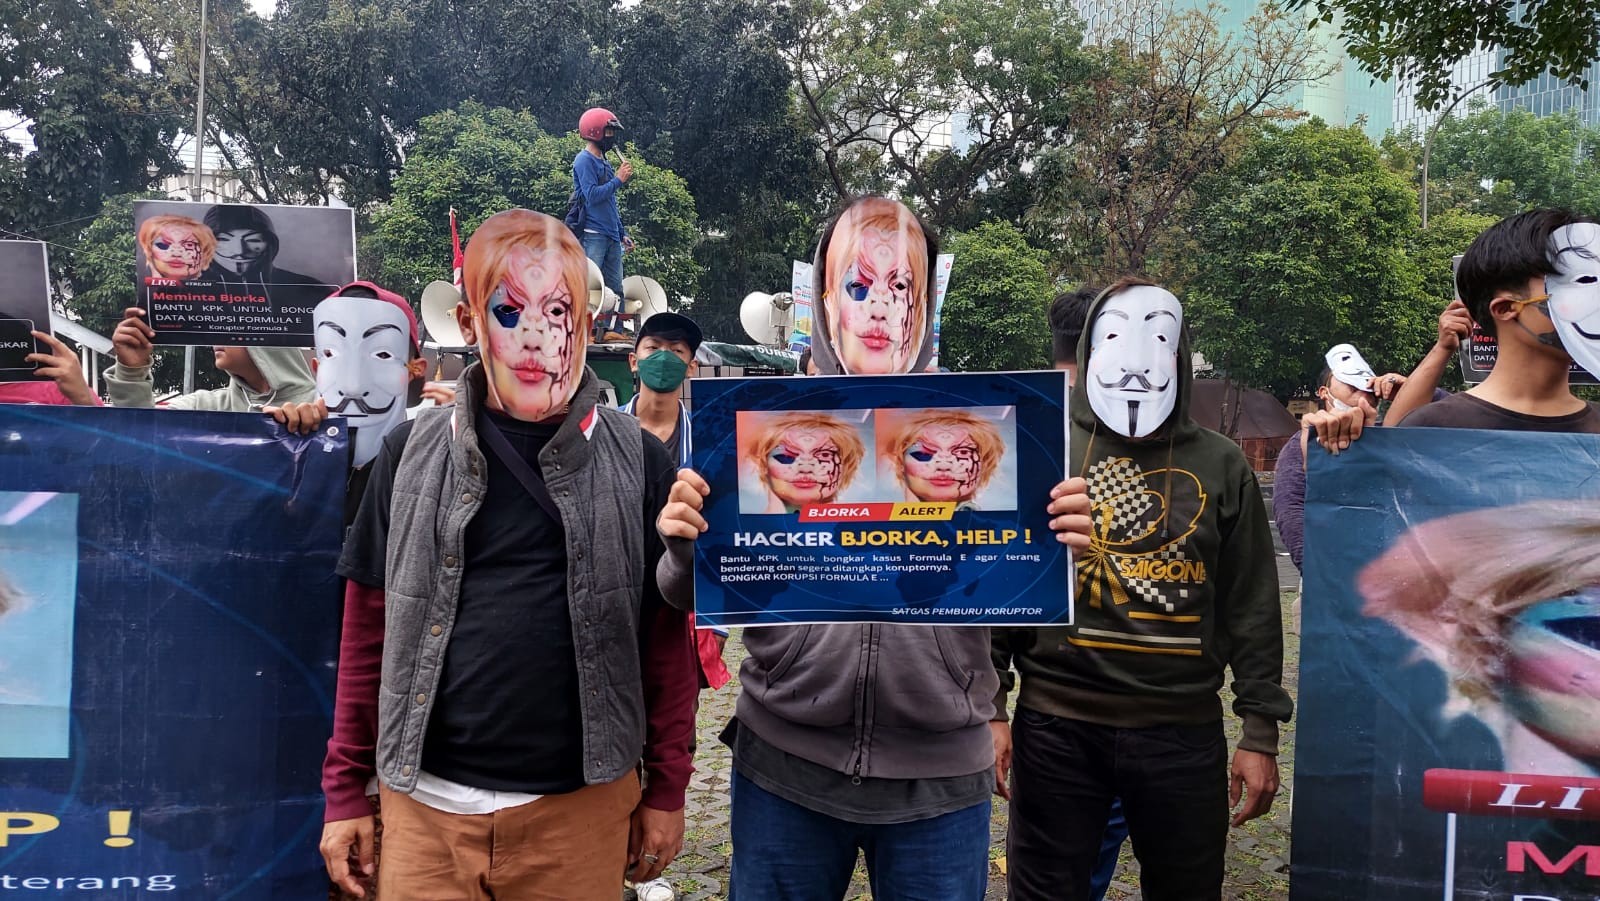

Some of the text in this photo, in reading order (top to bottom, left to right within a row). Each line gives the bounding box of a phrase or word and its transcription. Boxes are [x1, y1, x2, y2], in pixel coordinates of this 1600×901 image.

[151, 279, 177, 287] LIVE
[153, 292, 266, 304] Meminta Bjorka
[154, 303, 193, 311] BANTU
[232, 305, 272, 313] UNTUK
[281, 306, 314, 314] BONG
[208, 324, 245, 332] Koruptor
[808, 506, 946, 517] BJORKA ALERT
[734, 531, 835, 547] HACKER
[840, 530, 949, 548] BJORKA,
[956, 529, 1018, 545] HELP
[720, 555, 751, 563] Bantu
[758, 554, 779, 562] KPK
[823, 555, 865, 564] bongkar
[873, 554, 902, 562] kasus
[909, 554, 952, 562] Formula
[975, 554, 998, 563] agar
[1005, 553, 1041, 562] terang
[720, 563, 952, 573] benderang dan segera ditangkap koruptornya.
[720, 573, 771, 582] BONGKAR
[773, 573, 818, 581] KORUPSI
[820, 574, 869, 582] FORMULA
[891, 607, 1043, 616] SATGAS PEMBURU KORUPTOR
[1488, 783, 1600, 811] LI
[0, 874, 177, 892] terang
